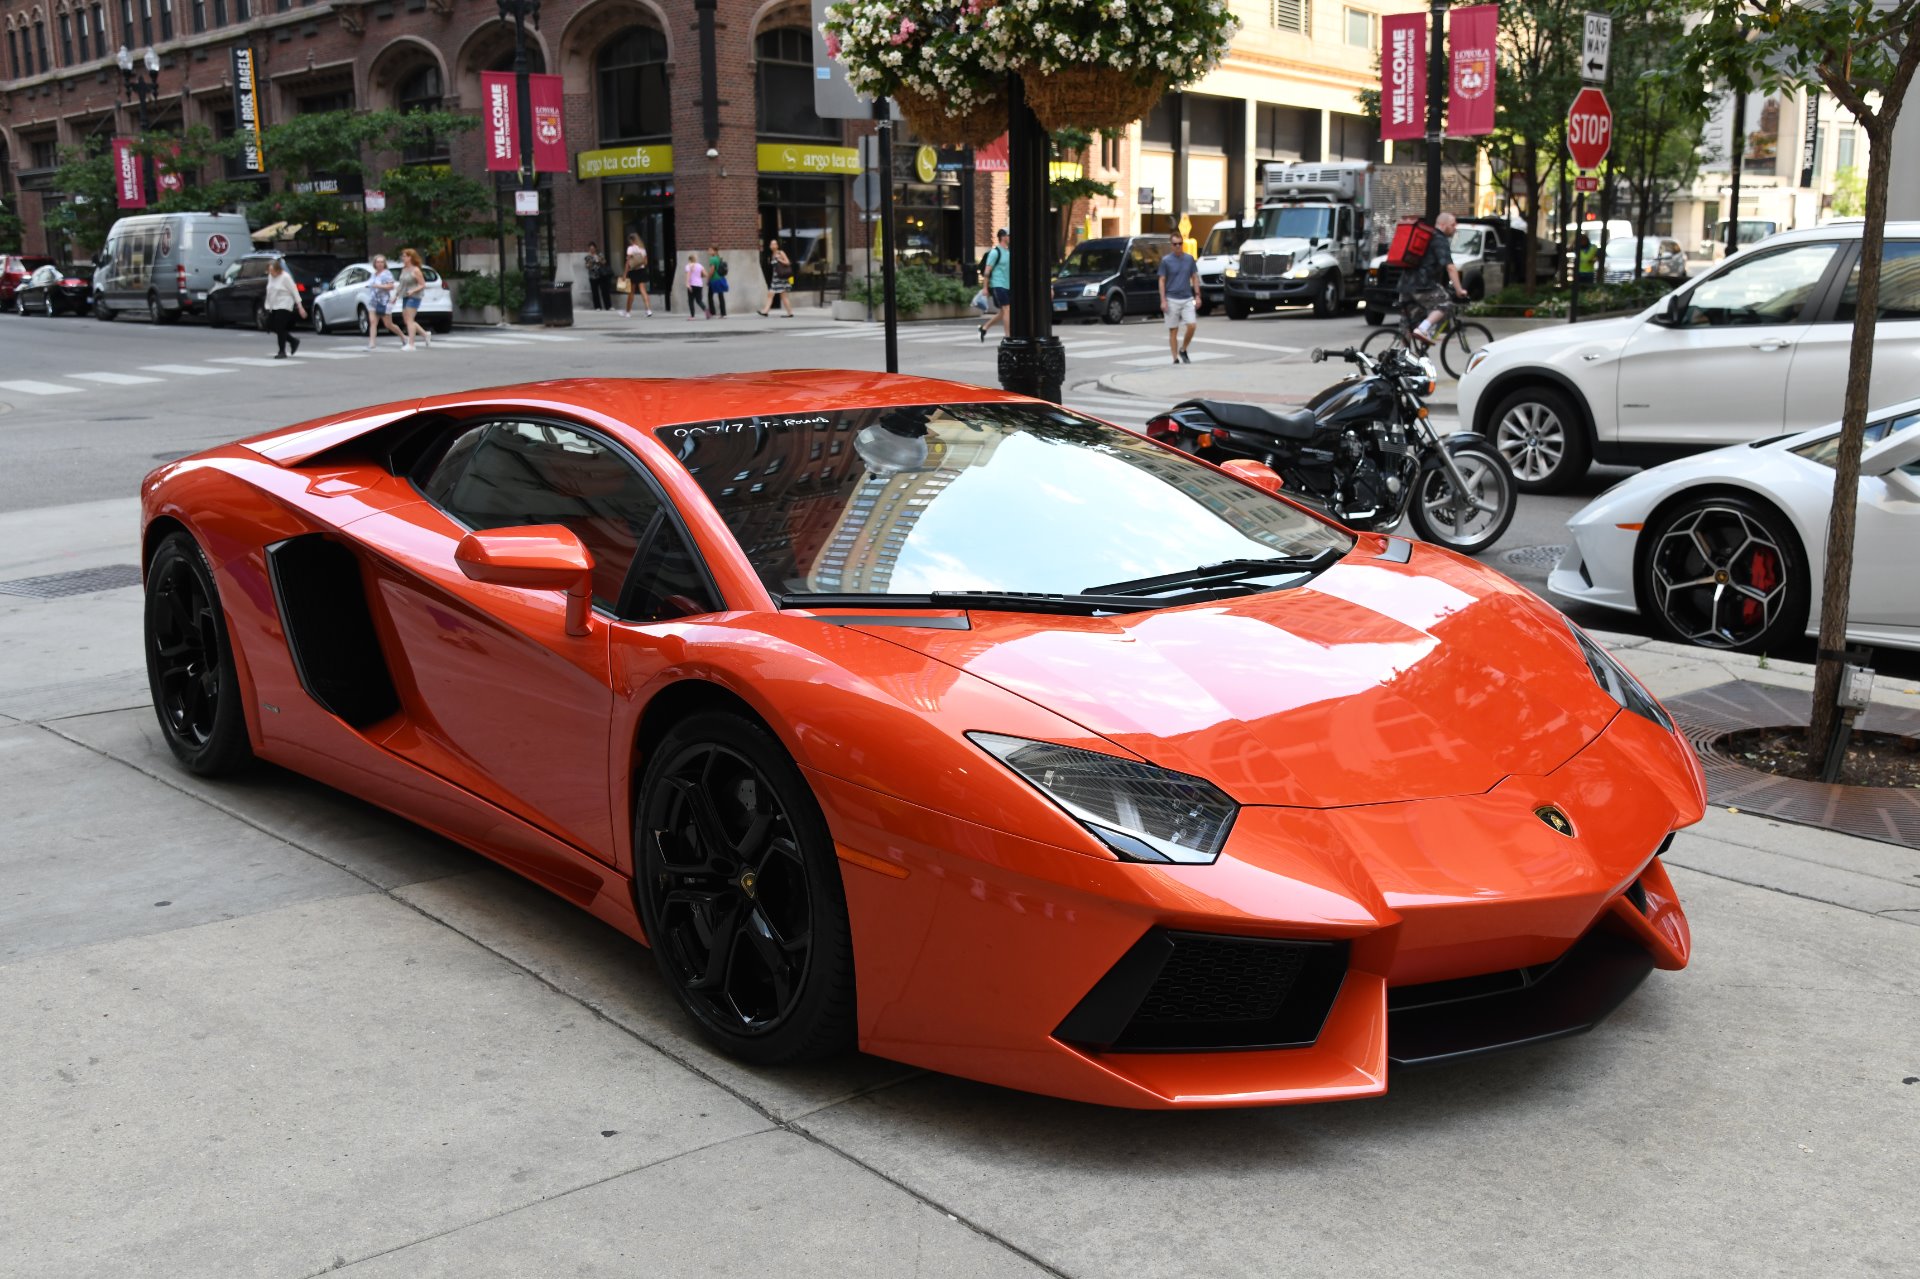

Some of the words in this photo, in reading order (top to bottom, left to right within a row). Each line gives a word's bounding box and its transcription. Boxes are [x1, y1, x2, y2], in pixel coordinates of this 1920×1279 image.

[1588, 20, 1608, 37] ONE
[1407, 29, 1415, 64] CAMPUS
[1454, 48, 1490, 60] LOYOLA
[1586, 41, 1607, 55] WAY
[237, 49, 253, 90] BAGELS
[1392, 29, 1406, 124] WELCOME
[491, 84, 506, 159] WELCOME
[1570, 113, 1609, 145] STOP
[604, 156, 618, 170] tea
[621, 147, 651, 169] café
[803, 153, 830, 171] argo
[832, 153, 846, 168] tea
[847, 150, 860, 169] caf
[975, 159, 1009, 170] LUMA
[121, 148, 134, 200] WELCOME
